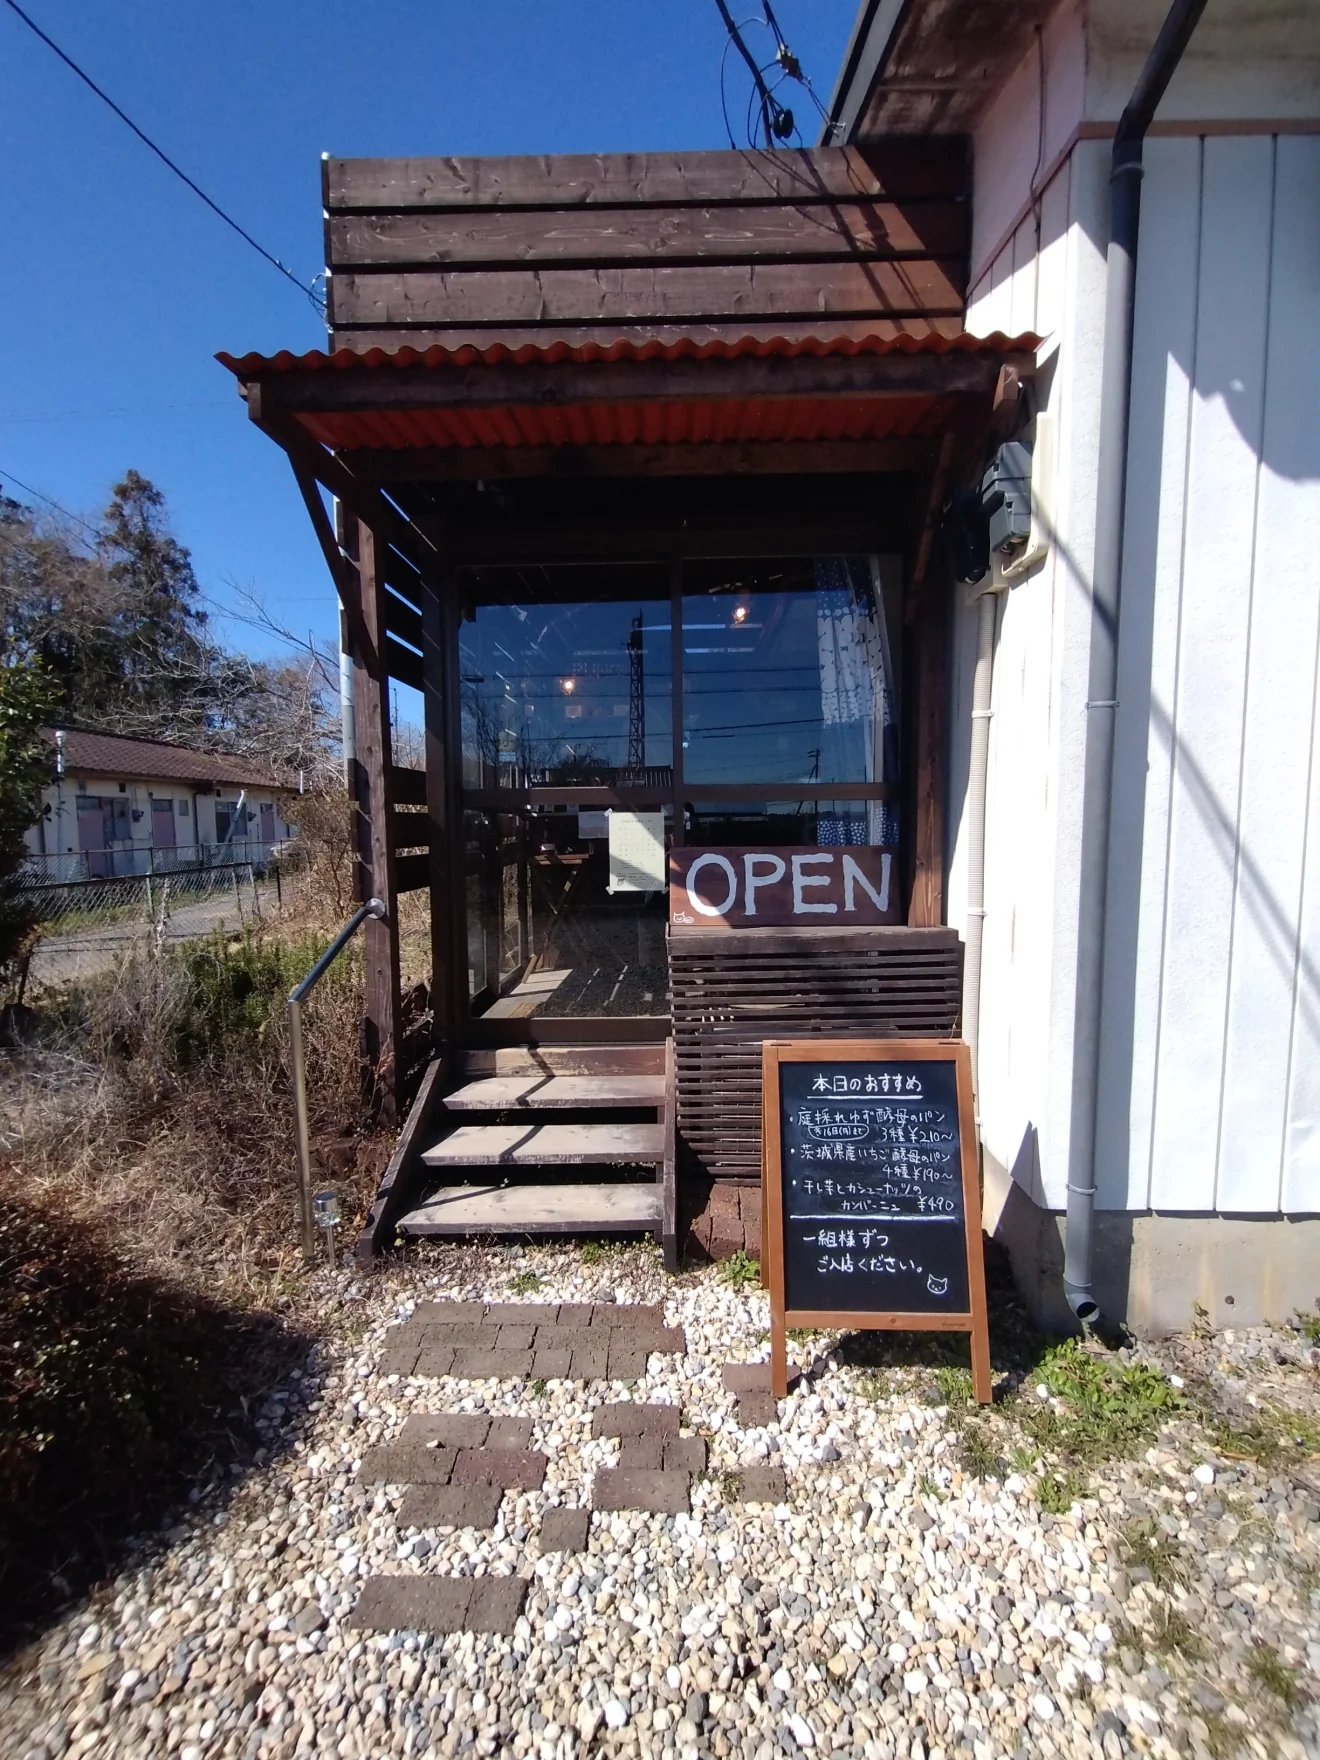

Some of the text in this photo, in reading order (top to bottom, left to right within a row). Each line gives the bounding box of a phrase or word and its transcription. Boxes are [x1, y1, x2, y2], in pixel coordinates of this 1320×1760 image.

[686, 853, 892, 916] OPEN
[812, 1072, 922, 1094] 本日のおすすめ
[882, 1164, 911, 1179] 4種
[803, 1179, 922, 1196] 干し芋とカシューナッツの
[841, 1196, 954, 1212] カンパーニュ ¥490
[803, 1228, 889, 1248] 一組様ずつ
[817, 1253, 922, 1273] ご入店ください。
